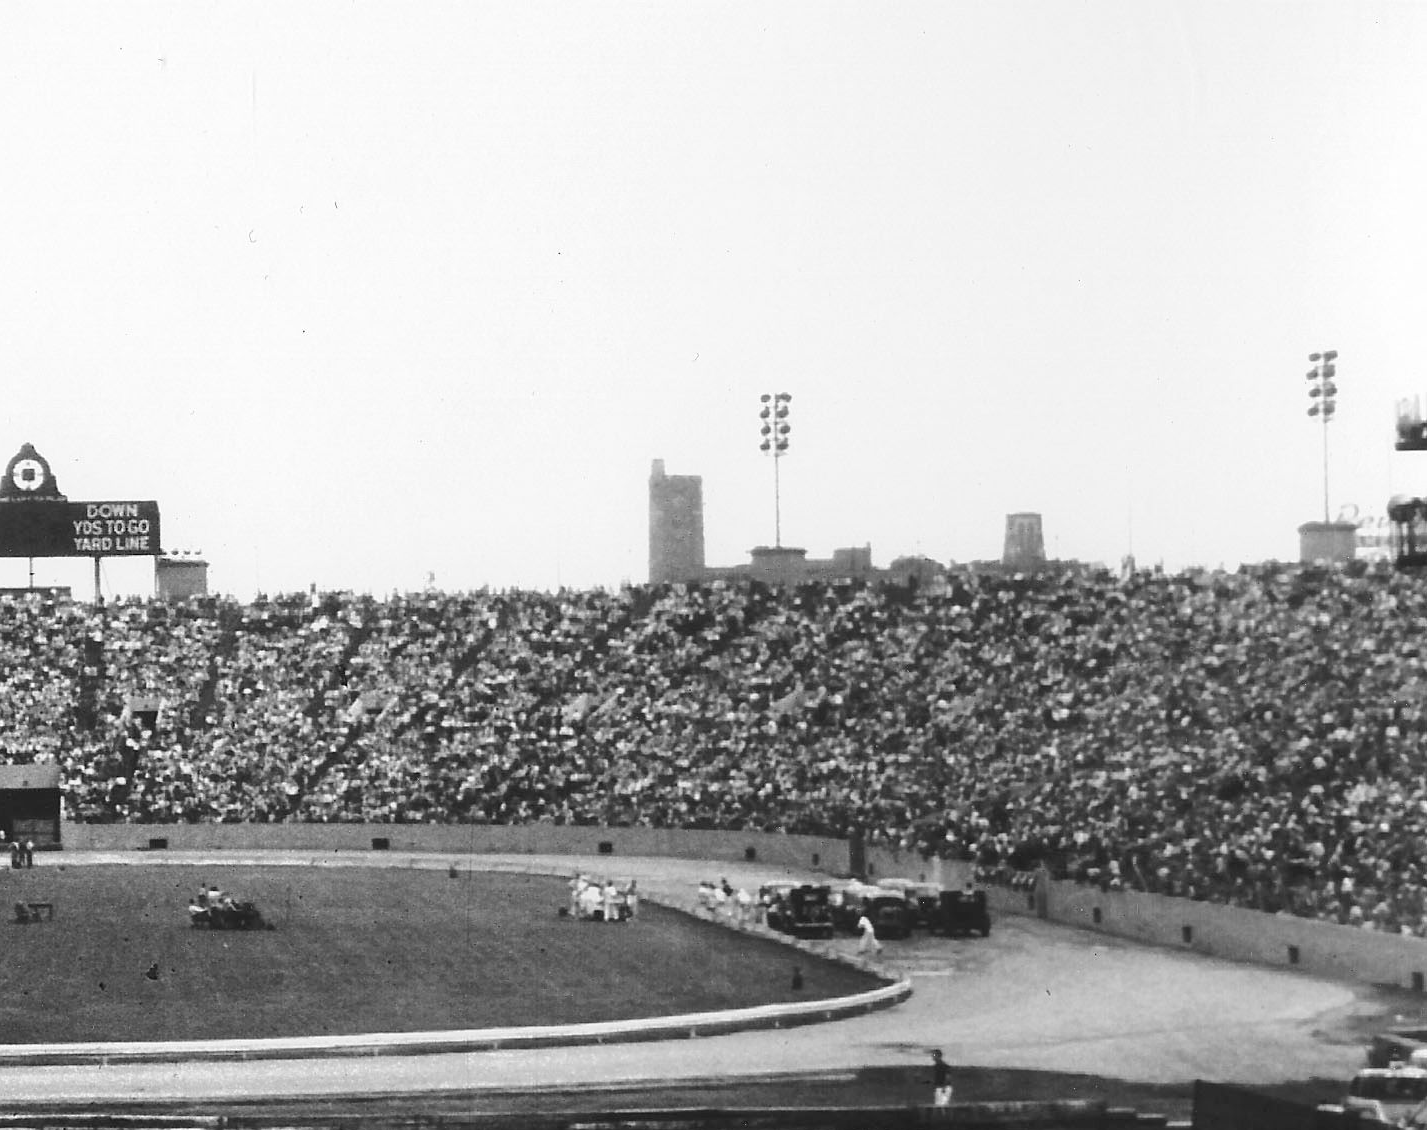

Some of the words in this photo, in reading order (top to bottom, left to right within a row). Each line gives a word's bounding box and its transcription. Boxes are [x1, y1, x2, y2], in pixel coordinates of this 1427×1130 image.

[86, 504, 138, 517] DOWN
[73, 520, 103, 535] YDS
[106, 520, 126, 535] TO
[127, 520, 150, 534] GO
[73, 537, 113, 551] YARD
[115, 535, 150, 551] LINE
